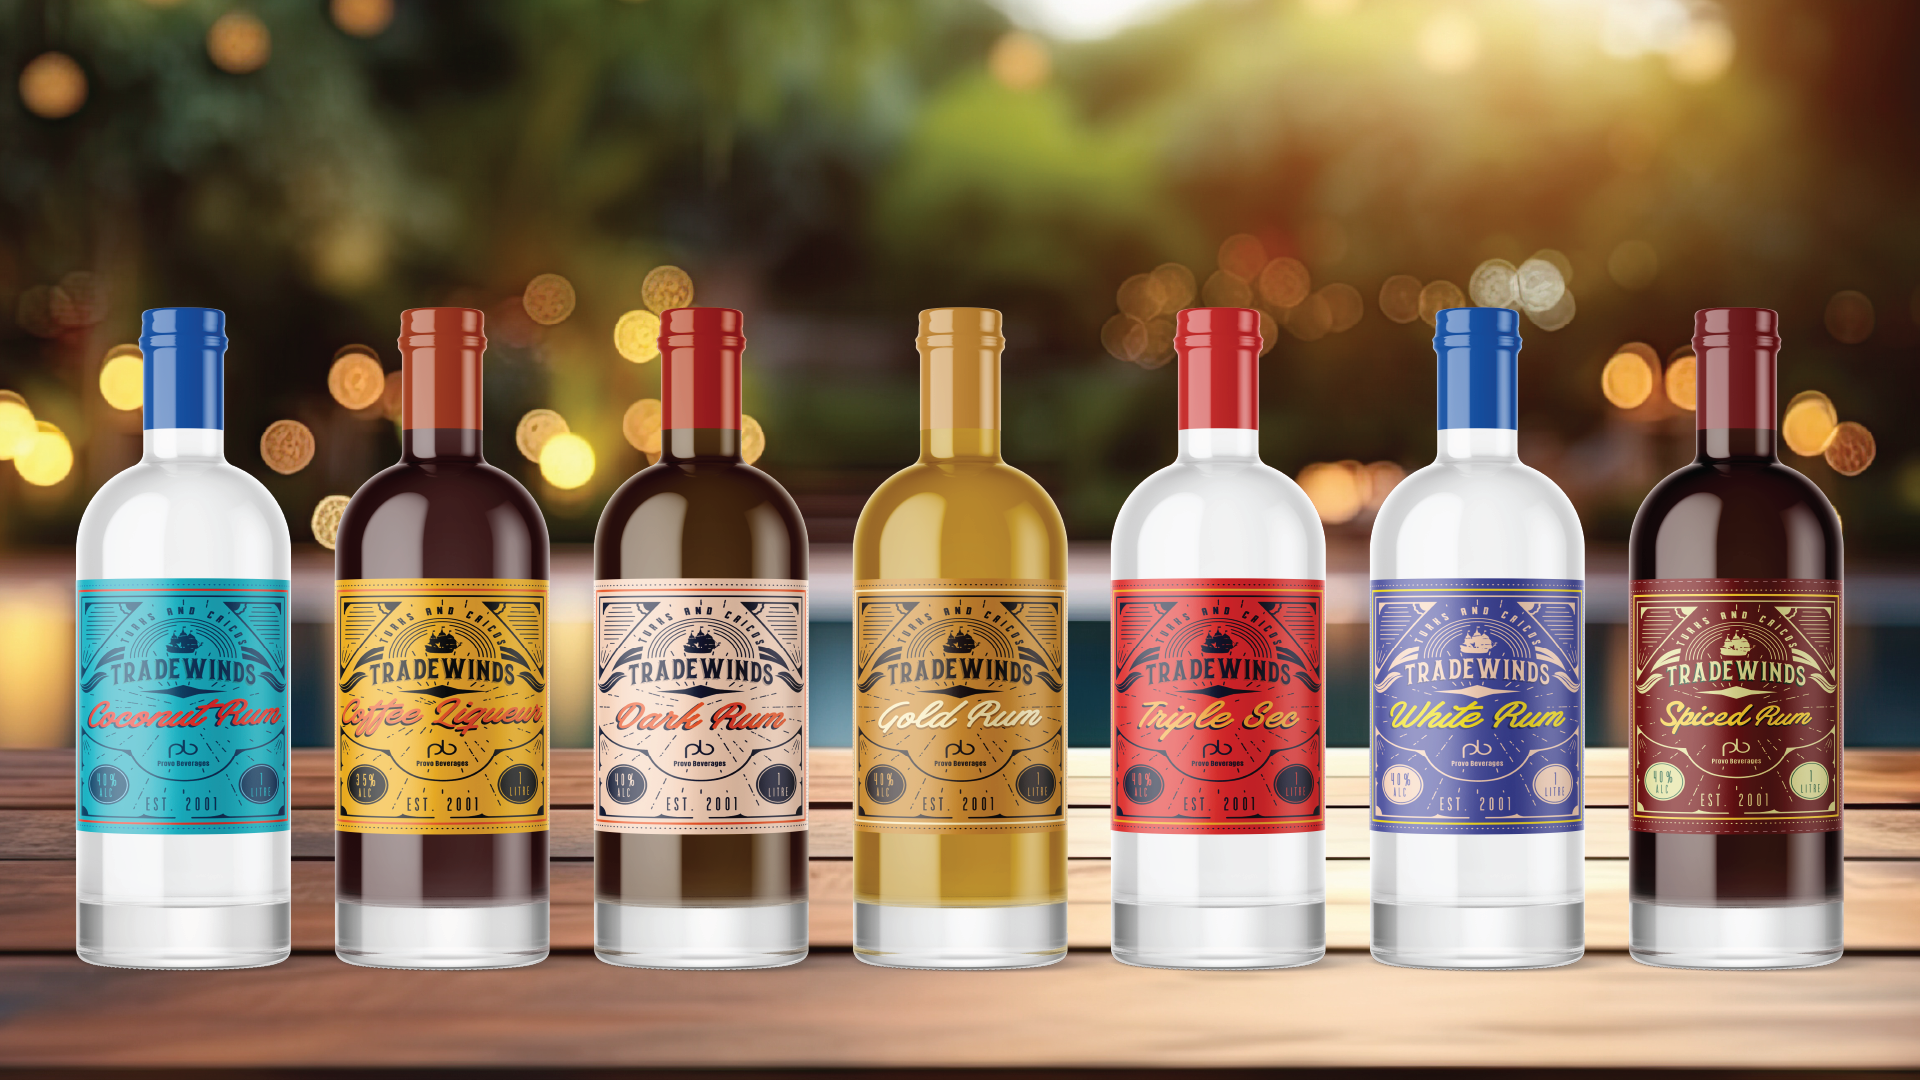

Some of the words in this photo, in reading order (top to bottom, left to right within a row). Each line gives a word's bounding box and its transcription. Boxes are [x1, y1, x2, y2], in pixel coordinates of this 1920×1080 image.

[166, 607, 195, 616] AND
[207, 611, 247, 646] CAICOS
[425, 607, 454, 616] AND
[466, 611, 506, 646] CAICOS
[684, 607, 713, 616] AND
[724, 611, 764, 646] CAICOS
[943, 607, 972, 616] AND
[984, 611, 1024, 646] CAICOS
[1201, 607, 1230, 616] AND
[1242, 611, 1282, 646] CAICOS
[1460, 607, 1489, 616] AND
[1501, 611, 1541, 646] CAICOS
[1720, 611, 1748, 620] AND
[1759, 614, 1797, 648] CAICOS
[110, 658, 256, 686] TRADEWINDS
[369, 658, 515, 686] TRADEWINDS
[628, 658, 773, 686] TRADEWINDS
[887, 658, 1033, 686] TRADEWINDS
[1145, 658, 1291, 686] TRADEWINDS
[1404, 658, 1550, 686] TRADEWINDS
[1666, 660, 1806, 687] TRADEWINDS
[88, 699, 219, 728] Coconut
[216, 698, 281, 727] Rum
[342, 698, 424, 738] Coffee
[431, 697, 543, 736] Liqueur
[616, 702, 704, 731] Dark
[710, 702, 786, 730] Rum
[877, 700, 968, 734] Gold
[966, 700, 1043, 728] Rum
[1389, 700, 1484, 729] White
[1492, 700, 1566, 729] Rum
[1660, 700, 1752, 735] Spiced
[1754, 705, 1813, 727] Rum
[1137, 700, 1235, 742] Triple
[1241, 700, 1300, 730] Sec
[96, 773, 117, 787] 40%
[259, 772, 264, 785] 1
[355, 773, 376, 787] 35%
[518, 772, 523, 785] 1
[614, 773, 634, 787] 40%
[776, 772, 781, 785] 1
[873, 773, 894, 787] 40%
[1036, 772, 1041, 785] 1
[1131, 773, 1152, 787] 40%
[1294, 772, 1299, 785] 1
[1390, 773, 1411, 787] 40%
[1553, 772, 1558, 785] 1
[1653, 769, 1673, 783] 40%
[1809, 770, 1813, 783] 1
[99, 788, 113, 798] ALC
[250, 786, 271, 797] LITRE
[358, 788, 372, 798] ALC
[509, 786, 530, 797] LITRE
[617, 788, 630, 798] ALC
[768, 786, 788, 797] LITRE
[876, 788, 890, 798] ALC
[1027, 786, 1048, 797] LITRE
[1134, 788, 1148, 798] ALC
[1285, 786, 1306, 797] LITRE
[1393, 788, 1407, 798] ALC
[1544, 786, 1565, 797] LITRE
[1655, 785, 1669, 794] ALC
[1800, 783, 1821, 794] LITRE
[146, 797, 173, 811] EST.
[186, 797, 217, 811] 2001
[407, 797, 435, 811] EST.
[447, 797, 478, 811] 2001
[667, 797, 694, 811] EST.
[706, 797, 738, 811] 2001
[923, 797, 950, 811] EST.
[963, 797, 994, 811] 2001
[1184, 797, 1212, 811] EST.
[1224, 797, 1255, 811] 2001
[1440, 797, 1467, 811] EST.
[1480, 797, 1511, 811] 2001
[1700, 793, 1727, 807] EST.
[1739, 793, 1769, 807] 2001
